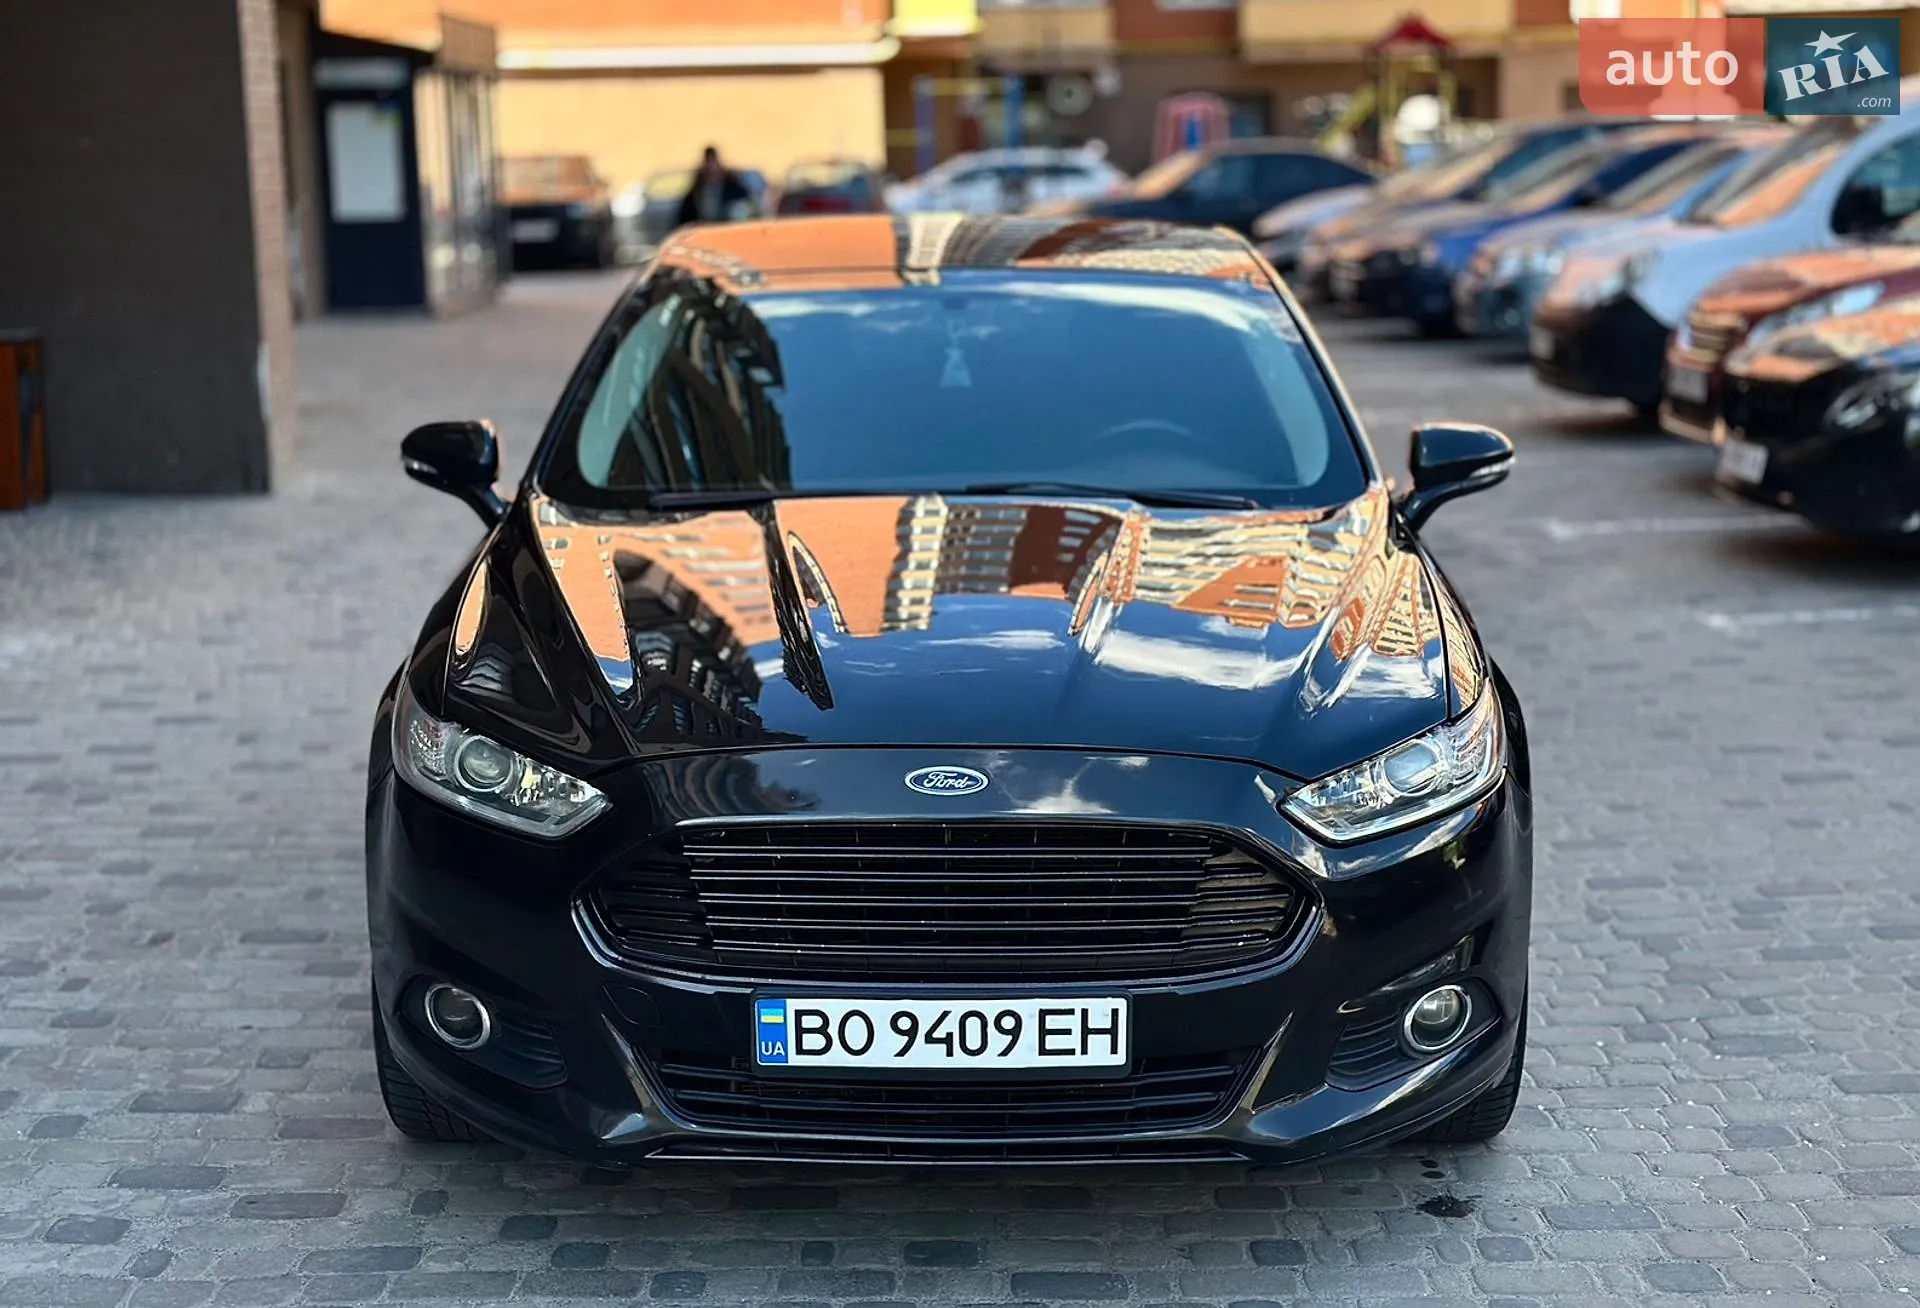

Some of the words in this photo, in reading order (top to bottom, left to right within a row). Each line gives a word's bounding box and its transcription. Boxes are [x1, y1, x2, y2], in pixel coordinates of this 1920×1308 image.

[923, 771, 974, 788] Ford
[889, 1010, 1023, 1058] 9409
[1037, 1008, 1120, 1057] EH
[761, 1041, 786, 1057] UA
